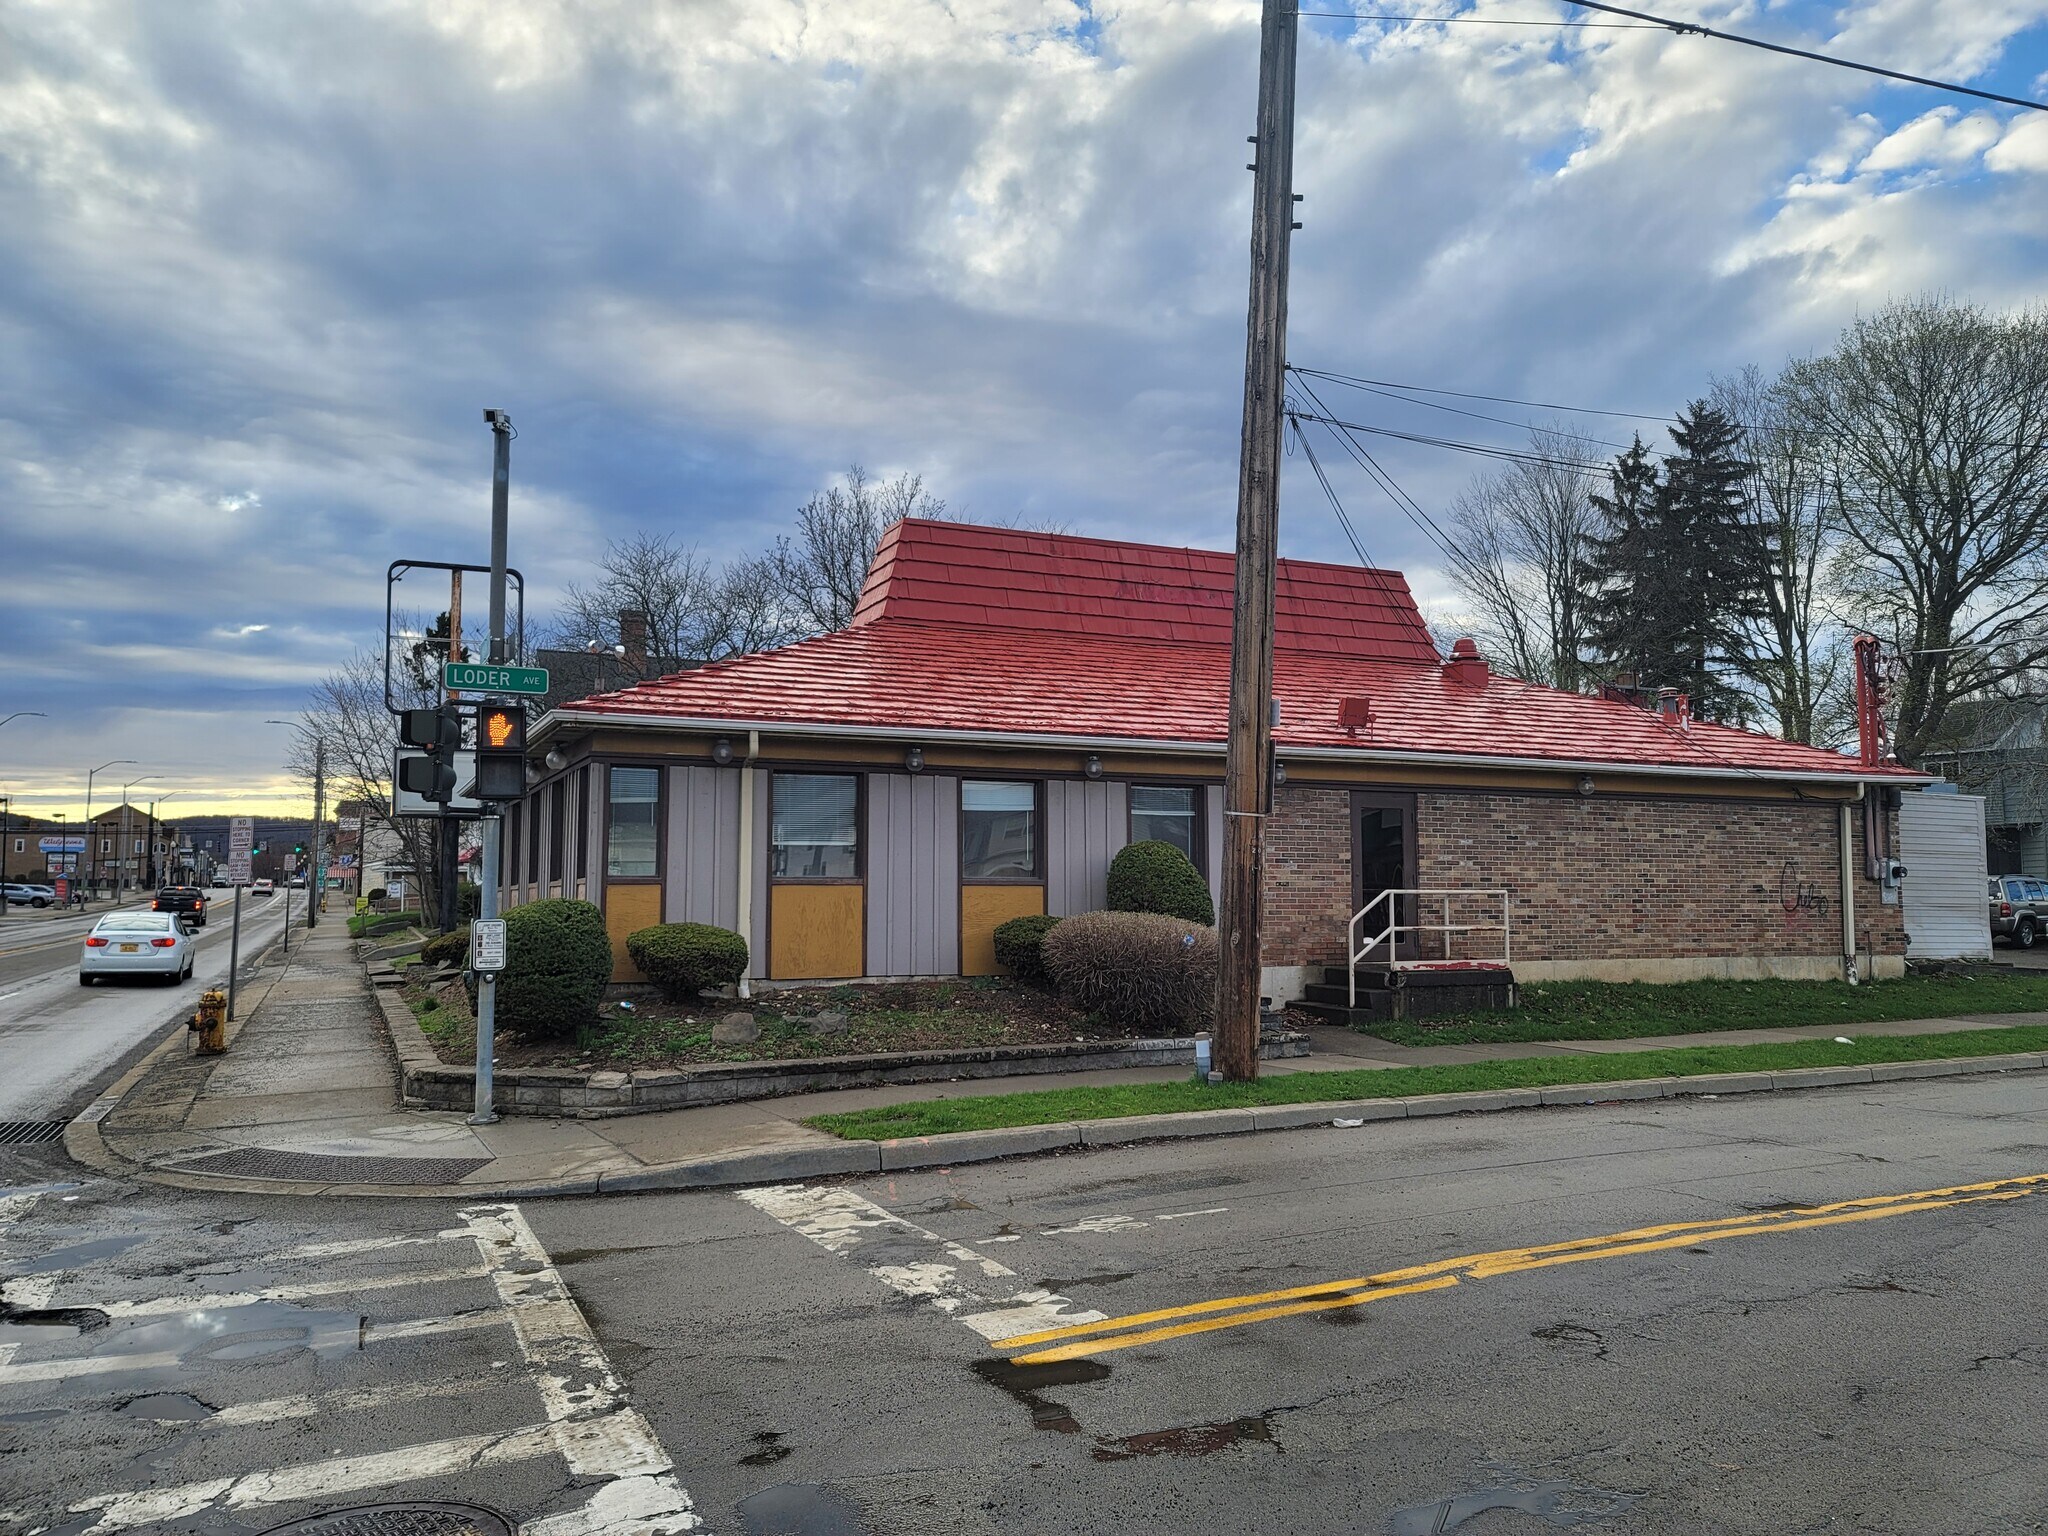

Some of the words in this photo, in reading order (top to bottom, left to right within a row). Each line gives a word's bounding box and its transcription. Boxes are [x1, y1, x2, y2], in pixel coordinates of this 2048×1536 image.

[453, 668, 510, 686] LODER
[523, 677, 540, 685] AVE
[43, 838, 82, 847] Walgeens
